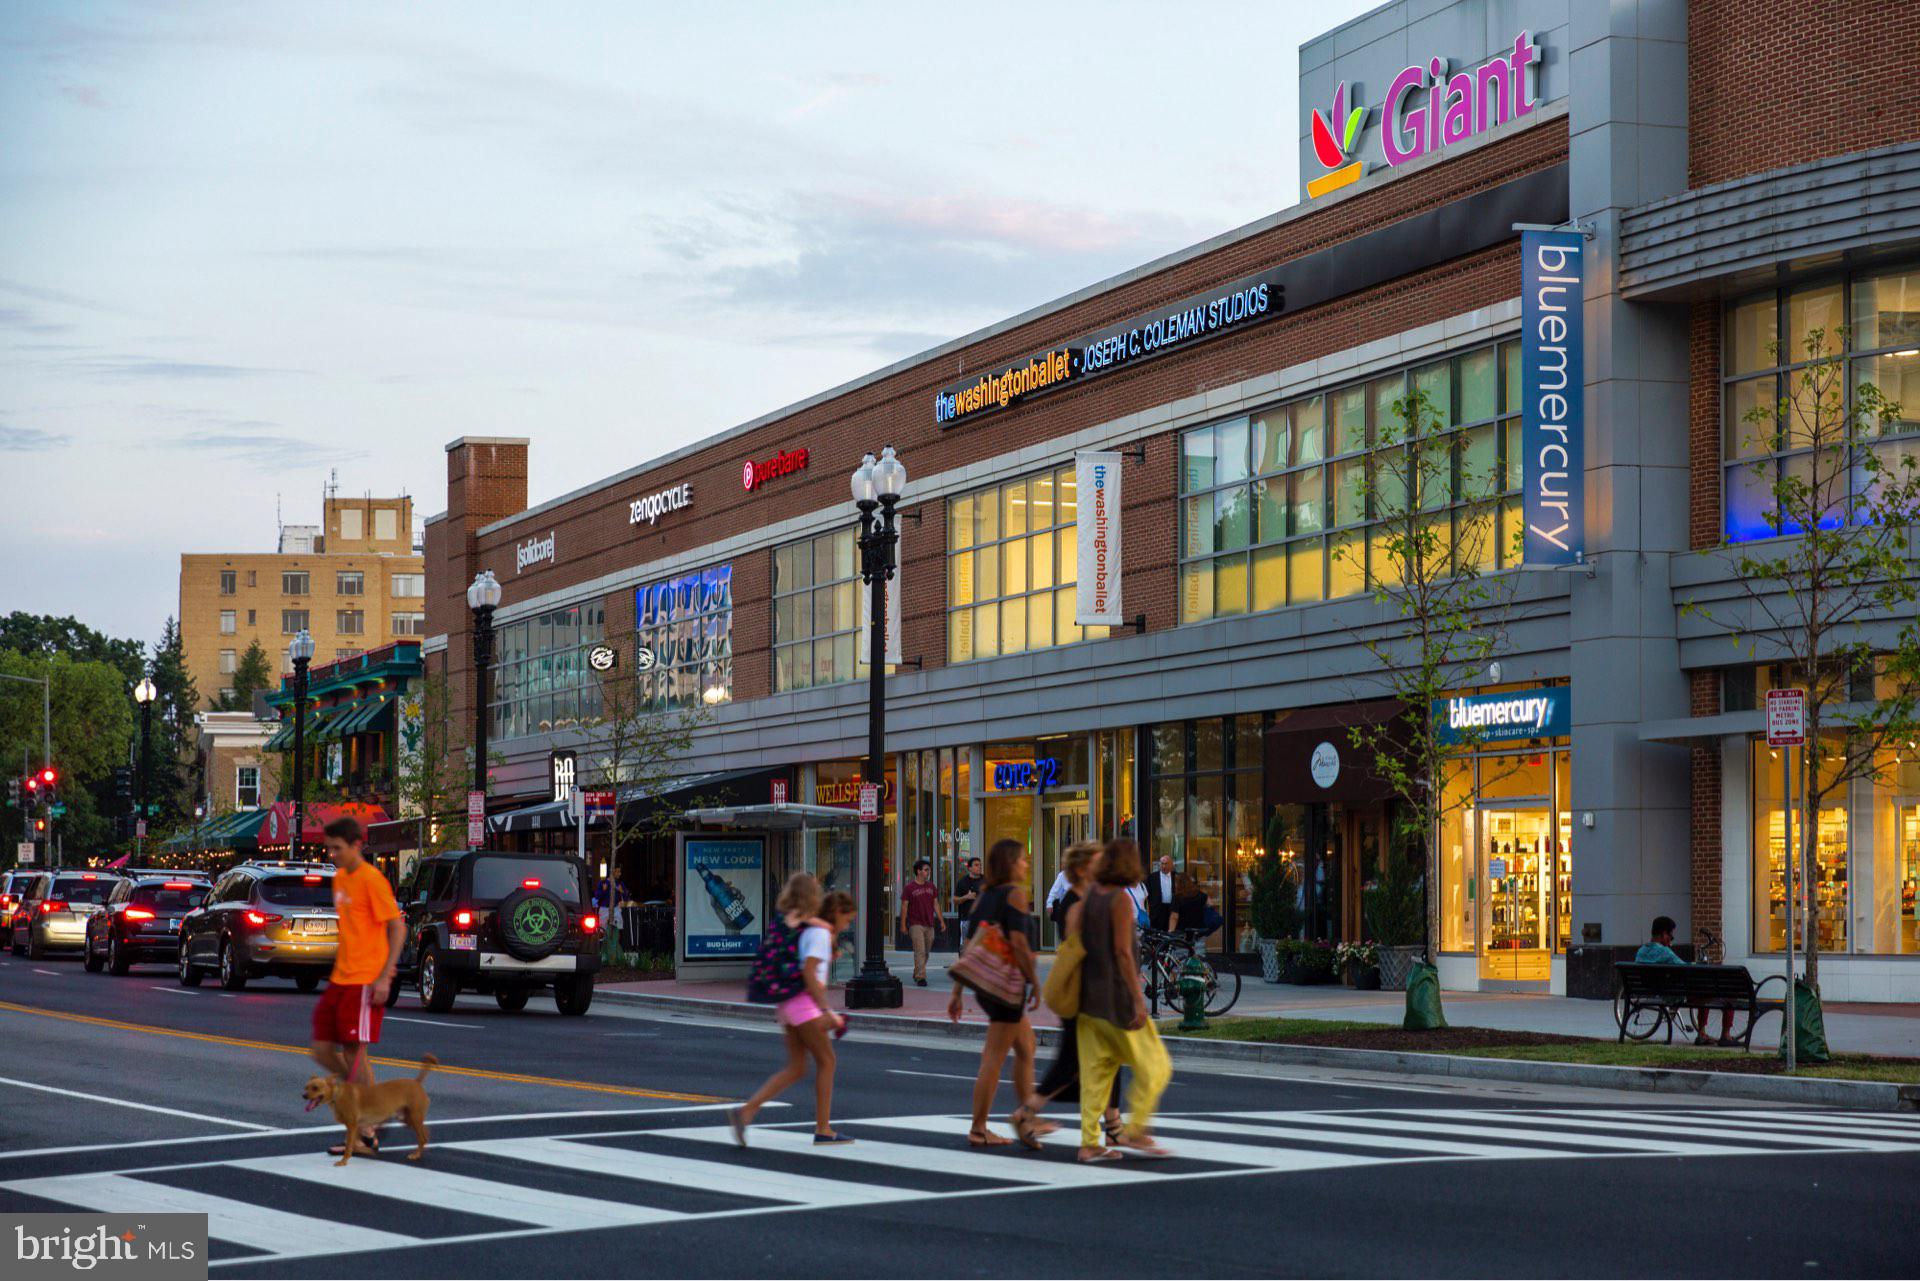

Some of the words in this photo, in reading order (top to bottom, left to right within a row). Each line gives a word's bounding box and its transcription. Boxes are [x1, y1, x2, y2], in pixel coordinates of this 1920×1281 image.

[1381, 29, 1538, 168] Giant
[936, 347, 1070, 423] thewashingtonballet
[1081, 333, 1126, 373] JOSEPH
[1129, 329, 1141, 355] C.
[1144, 309, 1205, 350] COLEMAN
[1208, 283, 1268, 328] STUDIOS
[1529, 245, 1580, 552] bluemercury
[1094, 465, 1108, 613] thewashingtonballet
[1450, 697, 1548, 729] bluemercury
[1495, 727, 1524, 737] skincare
[816, 781, 851, 805] WELLS
[693, 855, 720, 864] NEW
[724, 855, 755, 864] LOOK
[724, 899, 740, 914] BUD
